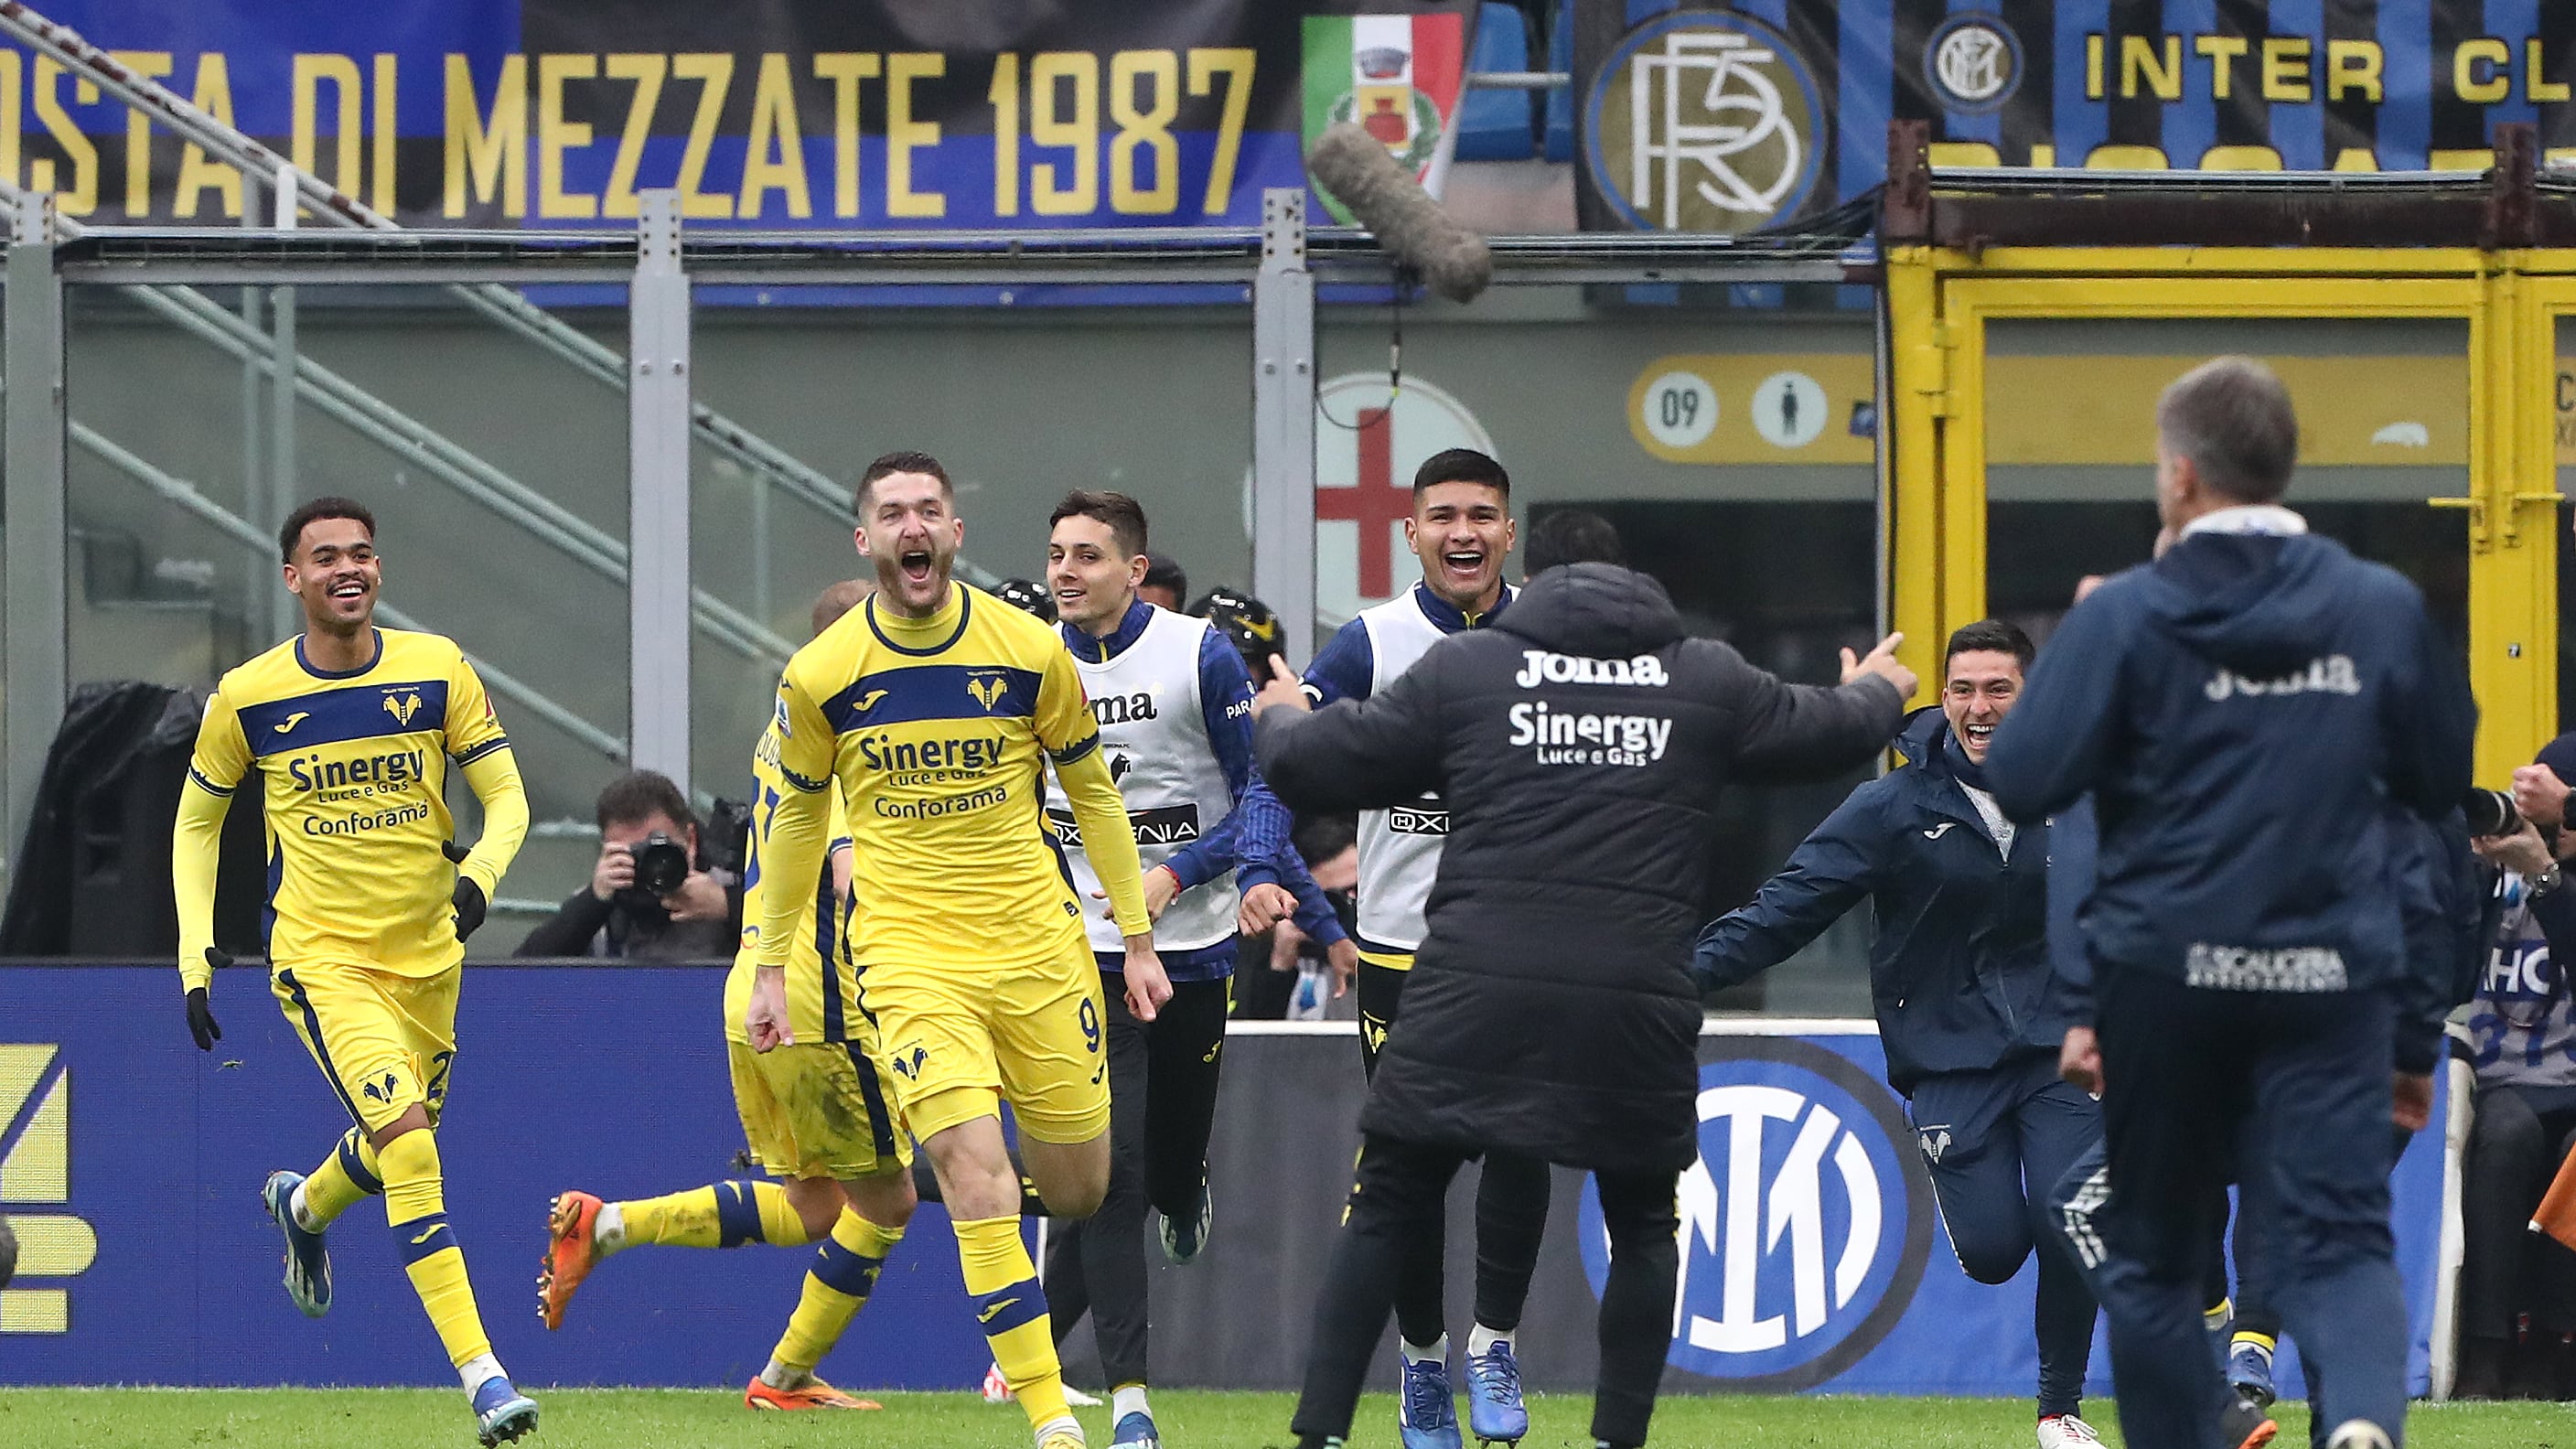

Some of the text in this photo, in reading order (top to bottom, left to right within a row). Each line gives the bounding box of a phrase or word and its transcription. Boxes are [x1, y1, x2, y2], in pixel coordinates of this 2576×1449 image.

[2086, 35, 2571, 103] INTER CL
[293, 52, 397, 220] DI
[445, 52, 947, 220] MEZZATE
[988, 48, 1257, 217] 1987
[1661, 388, 1700, 428] 09
[1515, 649, 1669, 688] Joma
[1509, 701, 1672, 760] Sinergy
[289, 749, 424, 792] Sinergy
[860, 735, 1004, 770] Sinergy
[1536, 746, 1647, 767] Luce e Gas
[318, 781, 409, 803] Luce e Gas
[888, 773, 930, 787] Luce
[937, 771, 946, 781] e
[304, 804, 428, 835] Conforama
[875, 785, 1007, 820] Conforama
[1079, 997, 1100, 1053] 9
